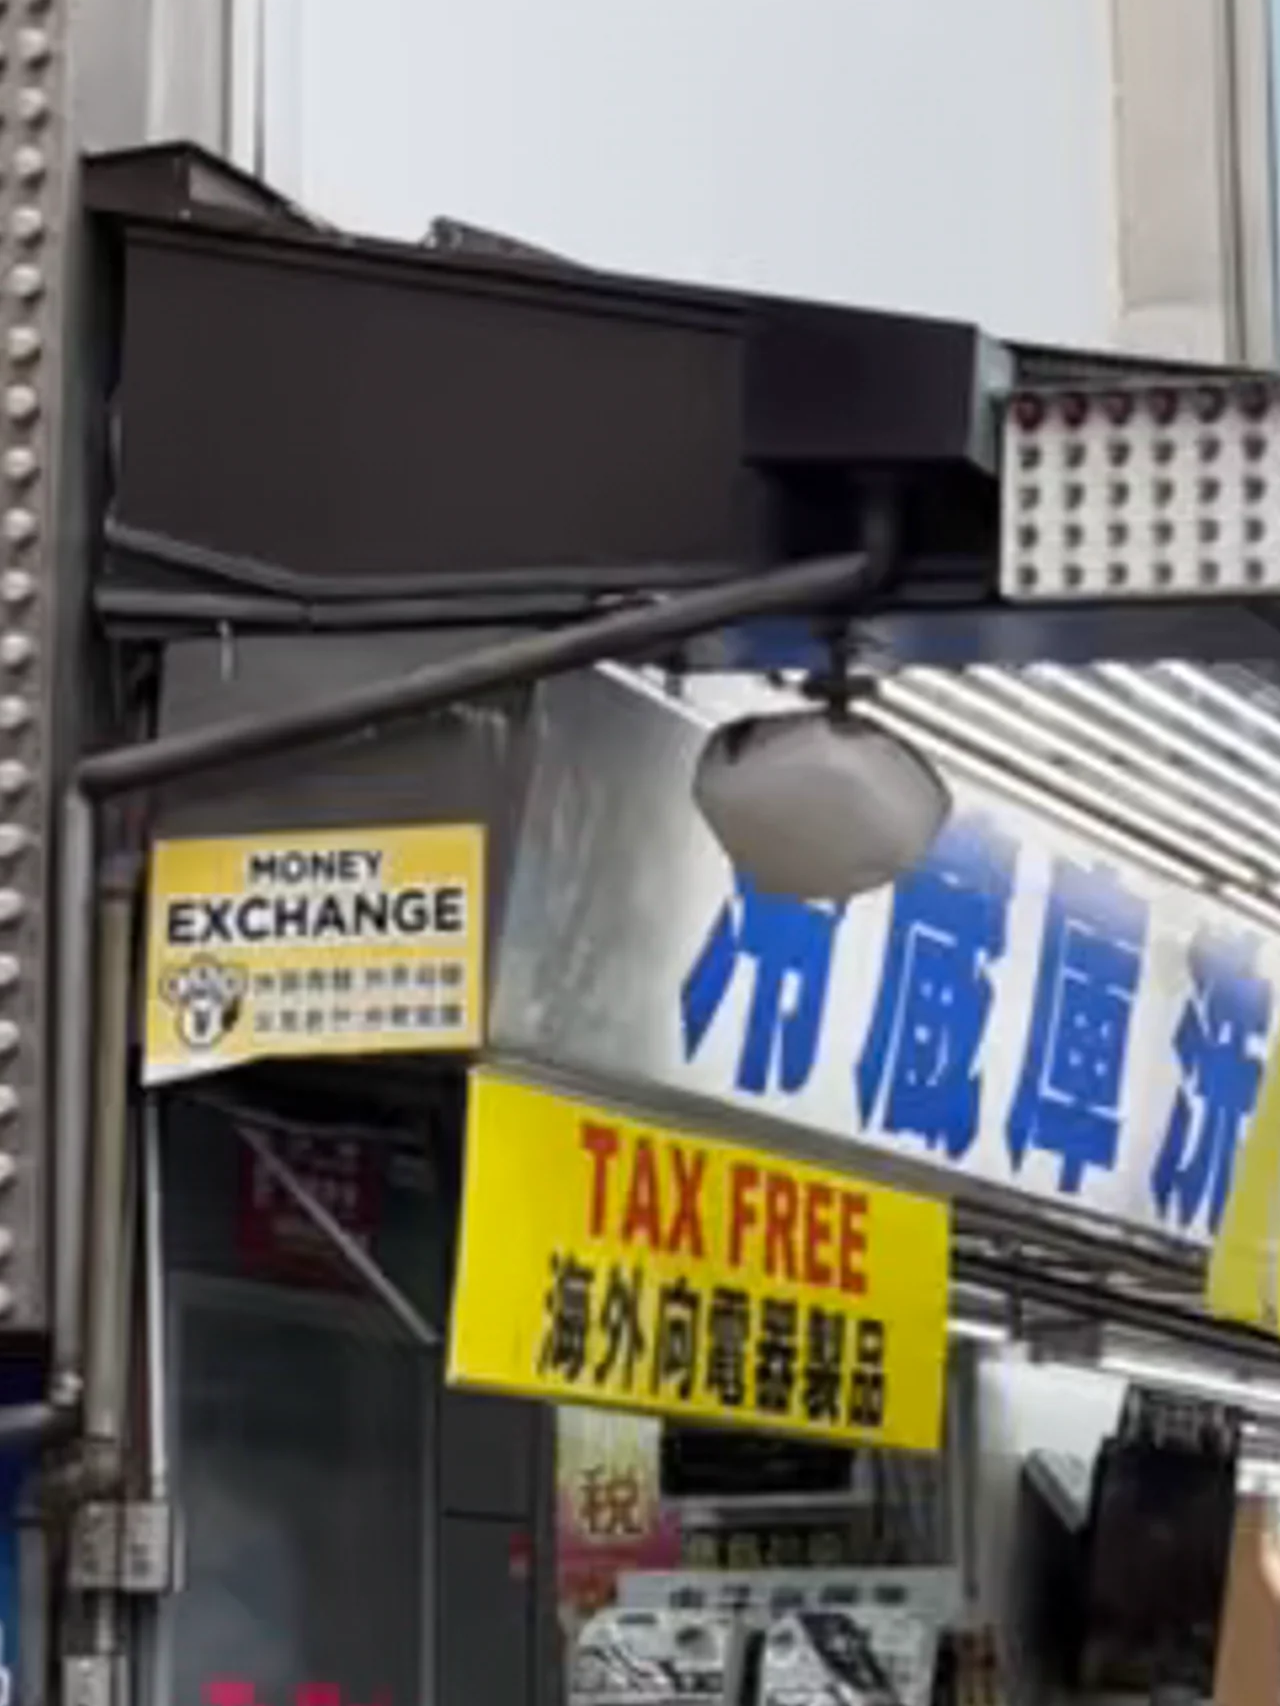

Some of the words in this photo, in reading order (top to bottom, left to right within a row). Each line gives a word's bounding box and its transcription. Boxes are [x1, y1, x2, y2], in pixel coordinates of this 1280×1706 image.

[250, 851, 382, 884] MONEY
[167, 888, 464, 943] EXCHANGE
[580, 1123, 707, 1260] TAX
[728, 1163, 869, 1297] FREE
